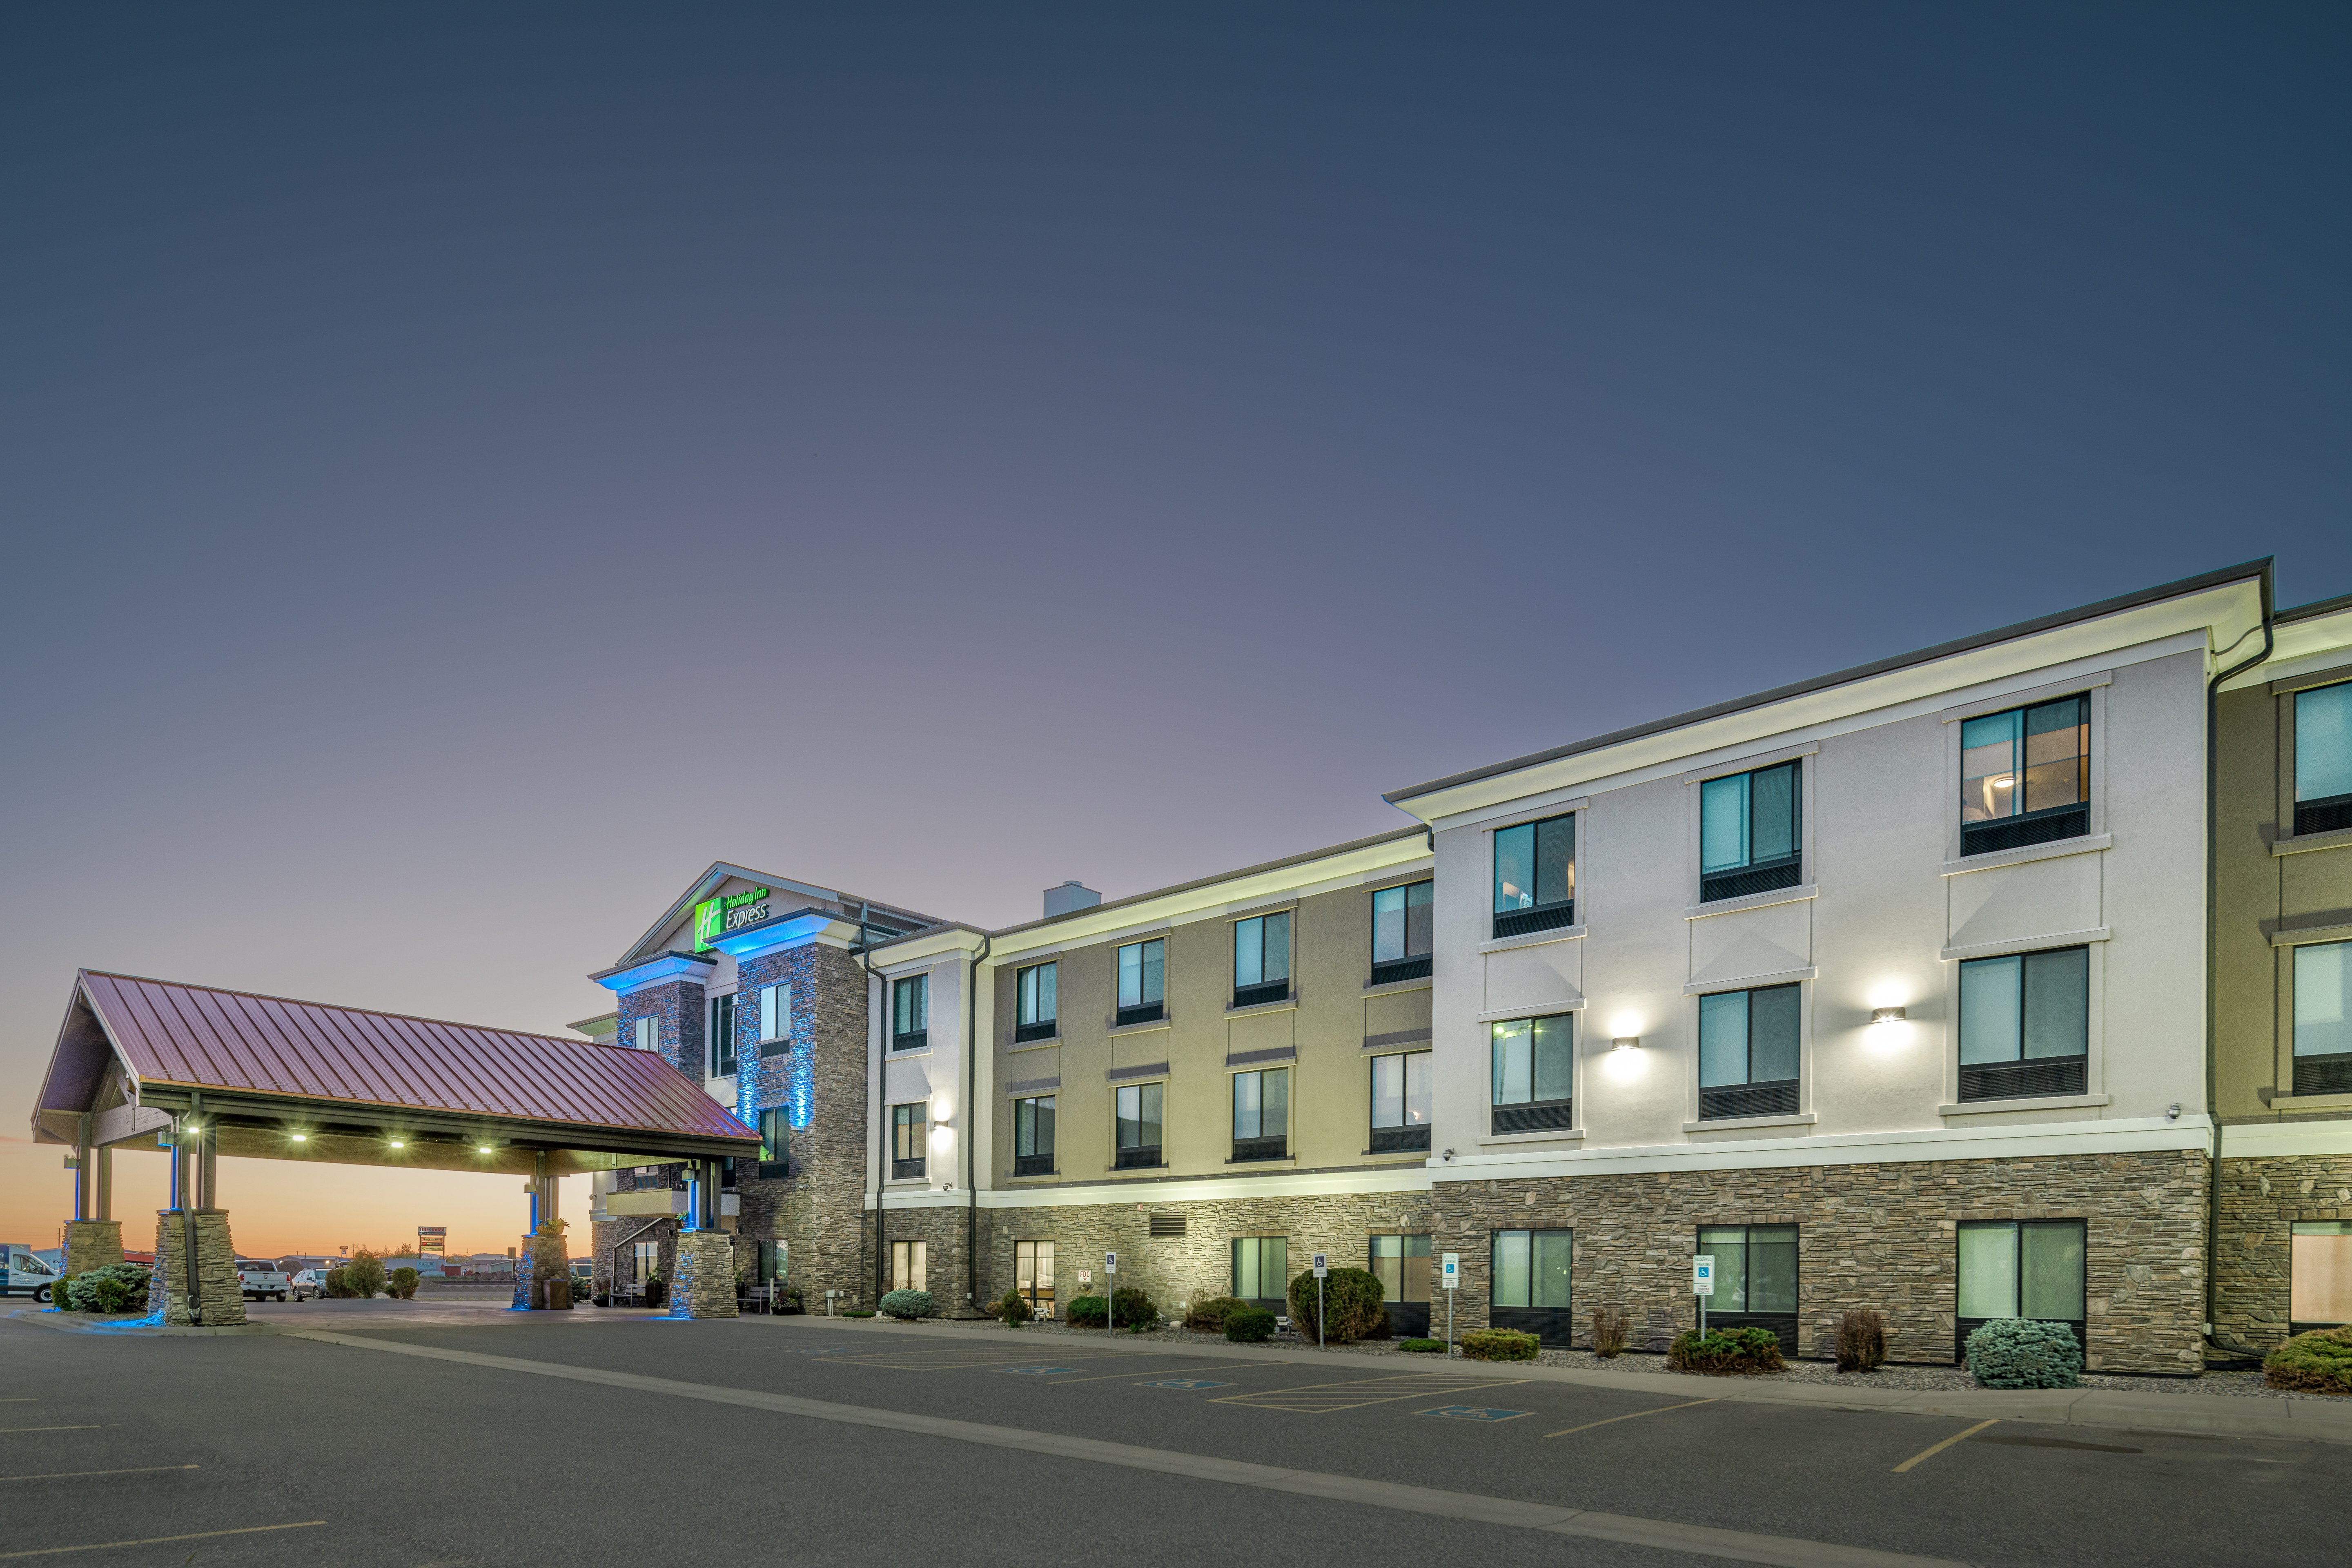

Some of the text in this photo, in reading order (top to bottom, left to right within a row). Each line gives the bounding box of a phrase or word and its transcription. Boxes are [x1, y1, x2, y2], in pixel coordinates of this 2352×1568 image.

[726, 886, 766, 909] Holiday Inn
[726, 904, 766, 929] Express
